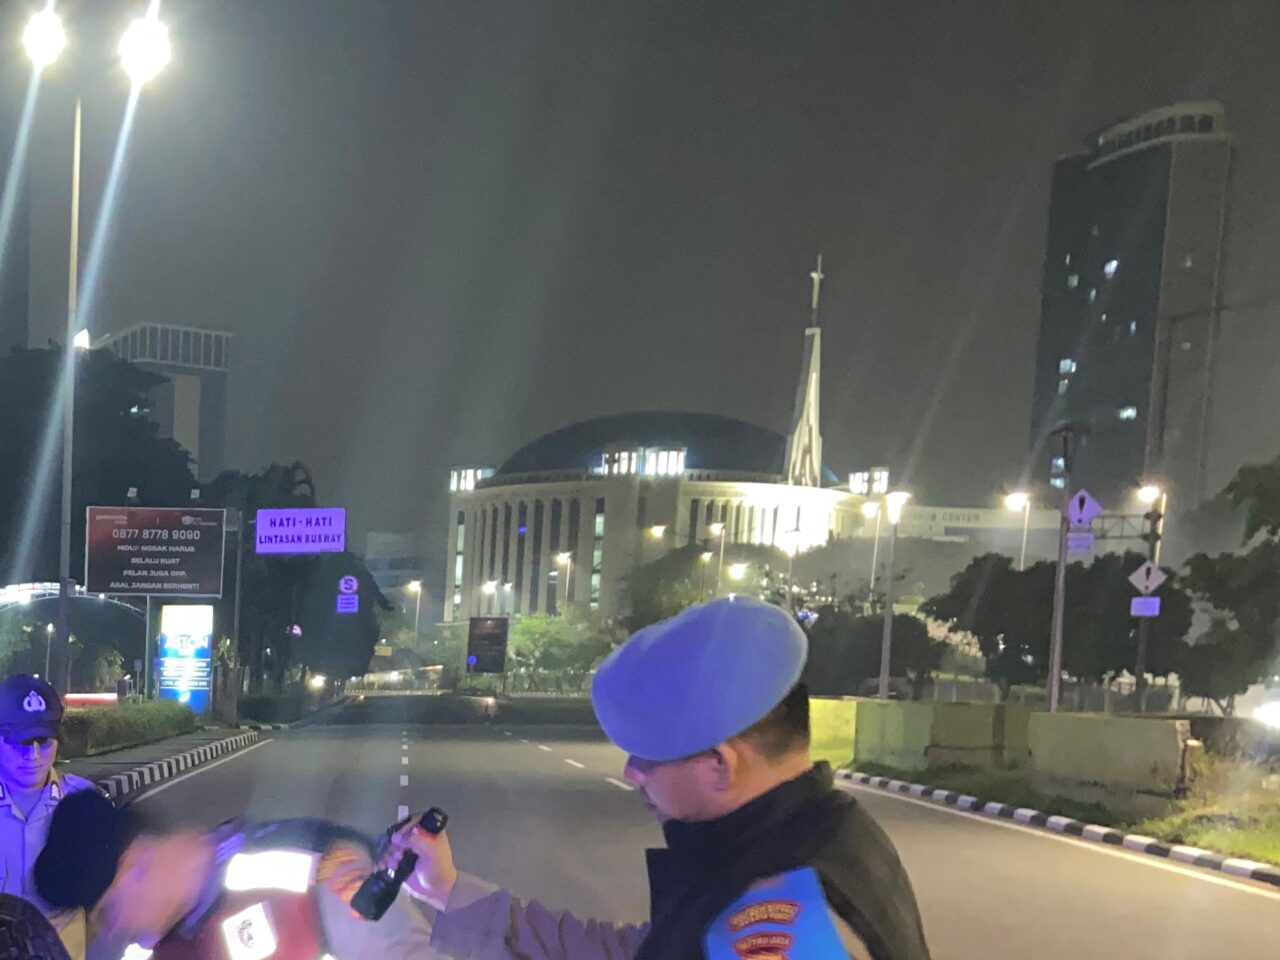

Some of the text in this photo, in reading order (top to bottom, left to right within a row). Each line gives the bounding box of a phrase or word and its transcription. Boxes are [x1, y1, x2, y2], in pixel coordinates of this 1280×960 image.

[112, 529, 200, 540] 0877 8778 9090
[259, 533, 342, 544] LINTASAN BUSWAY
[160, 557, 181, 565] KUAT
